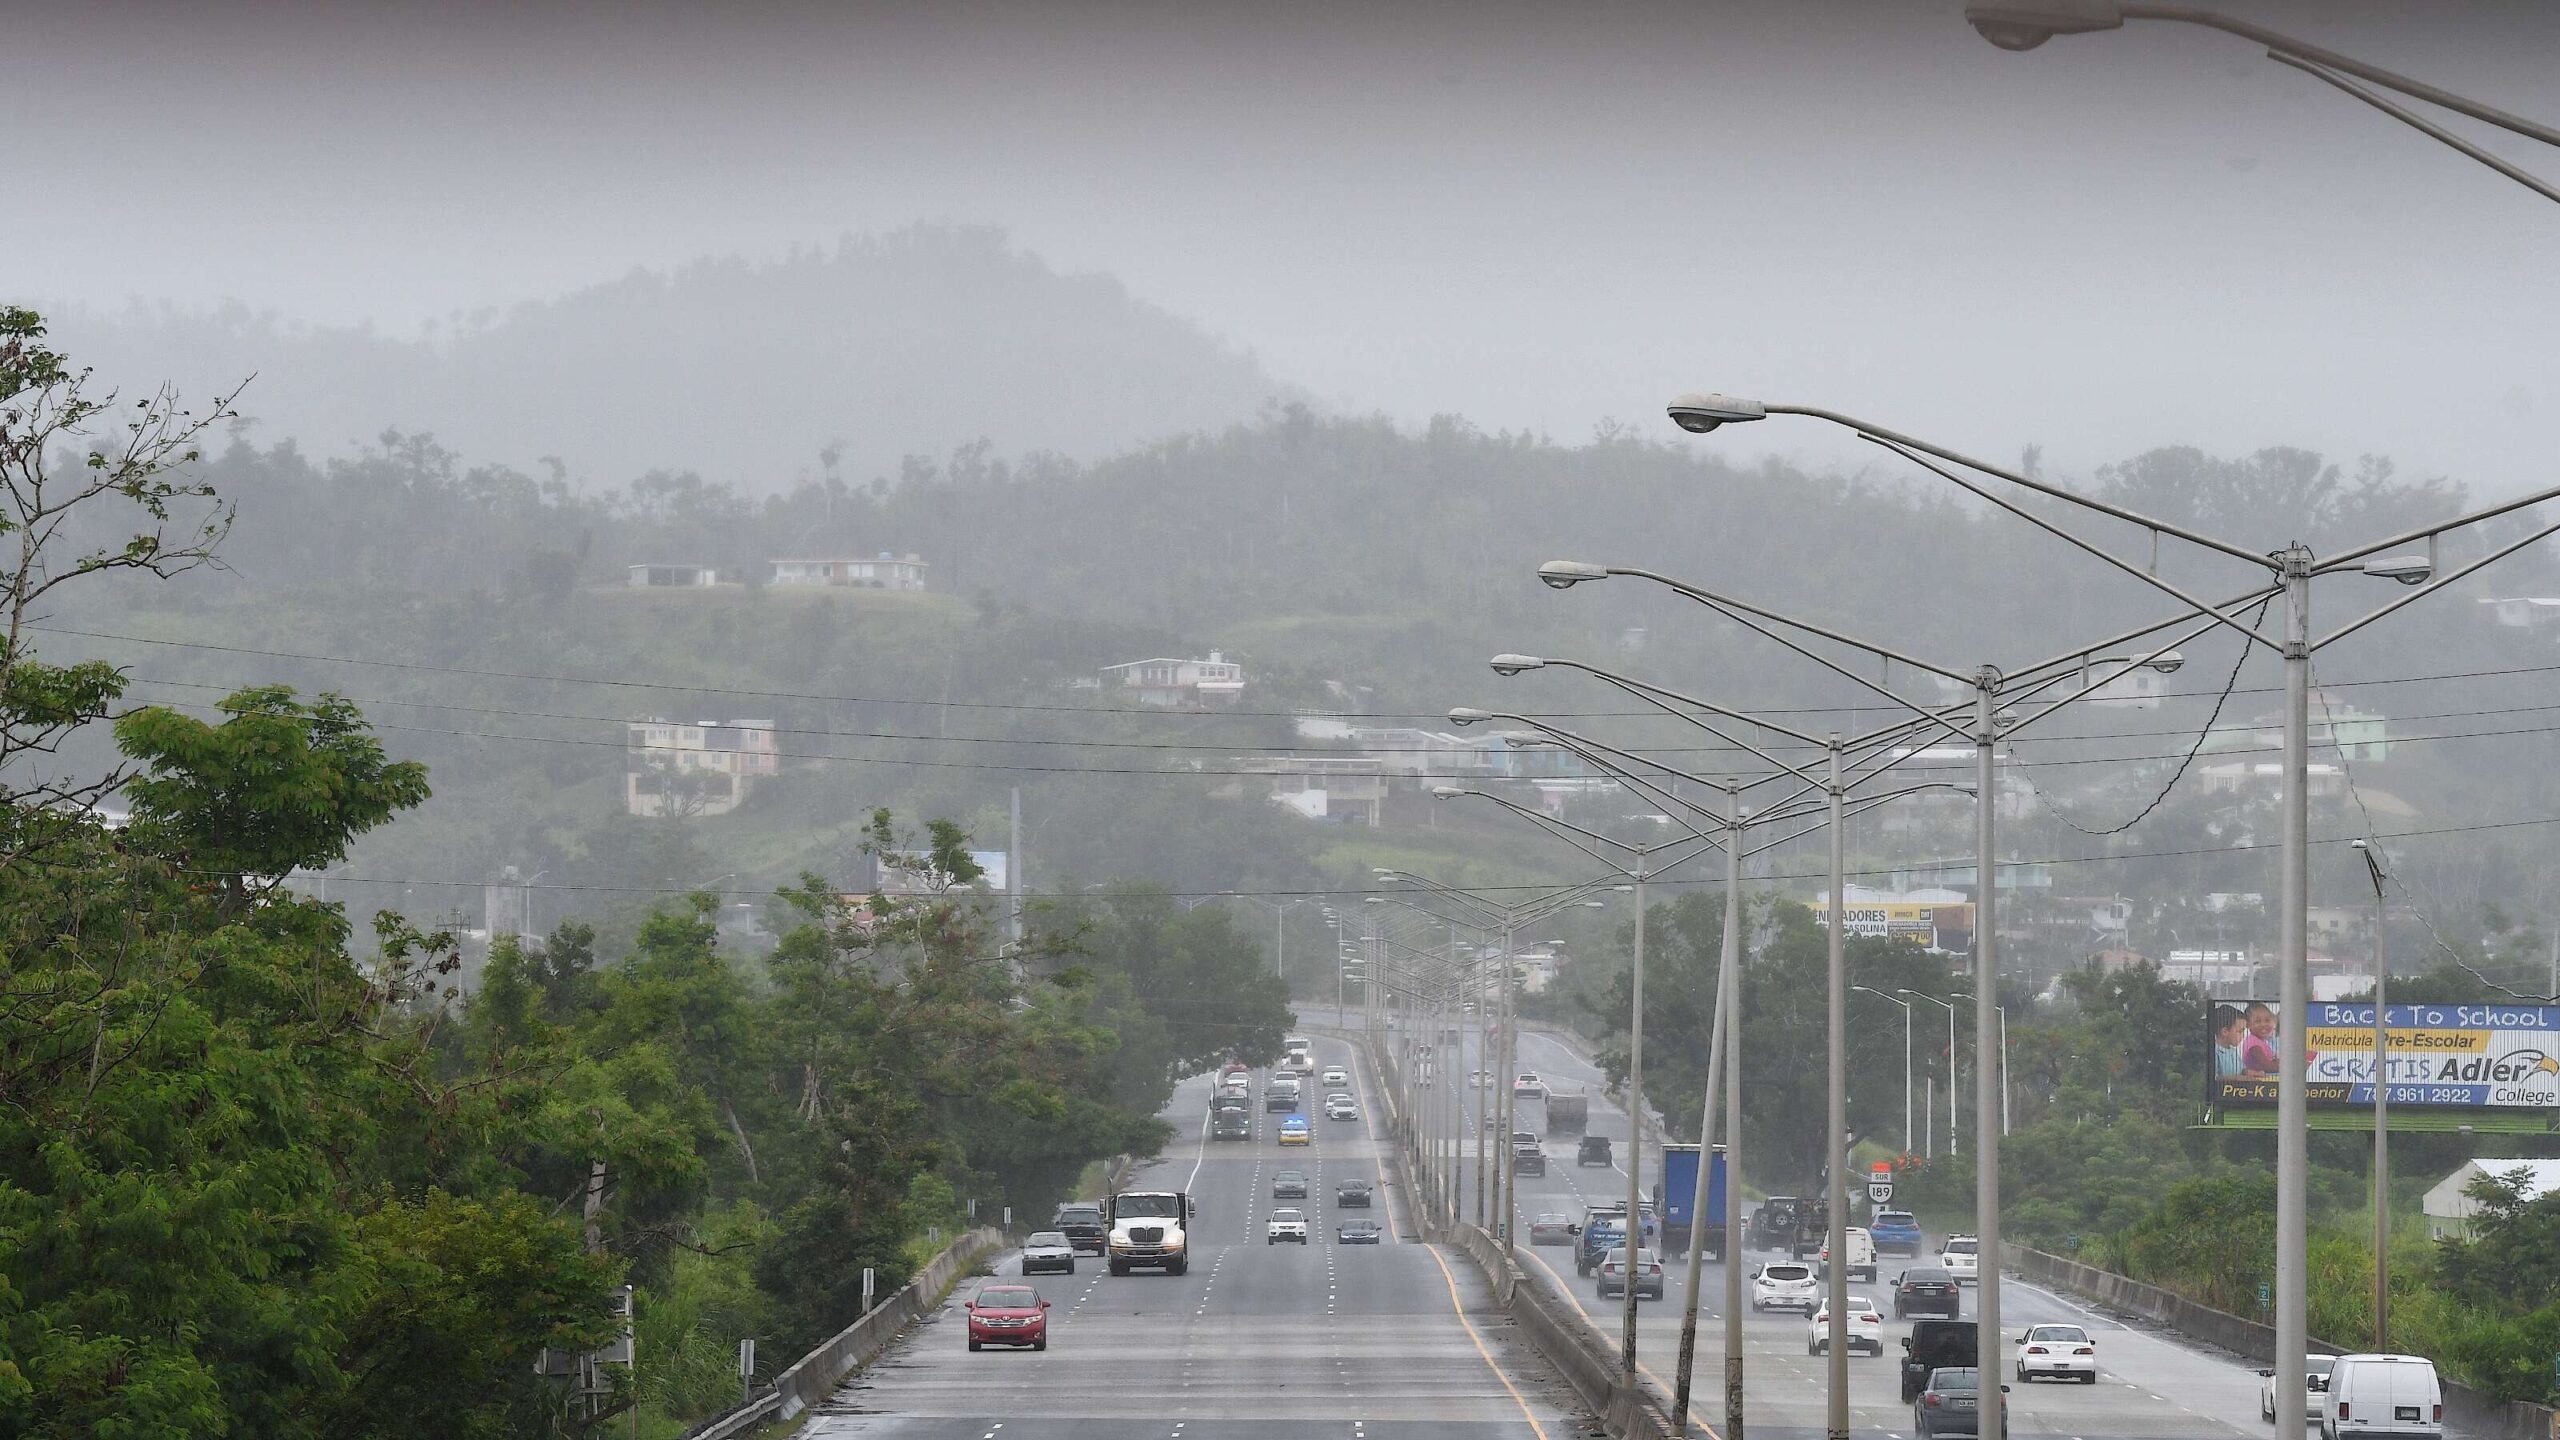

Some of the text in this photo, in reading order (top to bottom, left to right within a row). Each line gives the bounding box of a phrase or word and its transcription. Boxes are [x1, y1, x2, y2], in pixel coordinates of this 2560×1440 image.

[2407, 1004, 2444, 1026] To
[2457, 1004, 2549, 1027] School
[2437, 1057, 2528, 1083] Adler
[2222, 1084, 2345, 1100] Pre-K a erior
[2495, 1088, 2556, 1106] College
[1874, 1173, 1889, 1181] SUR
[1872, 1187, 1890, 1197] 189
